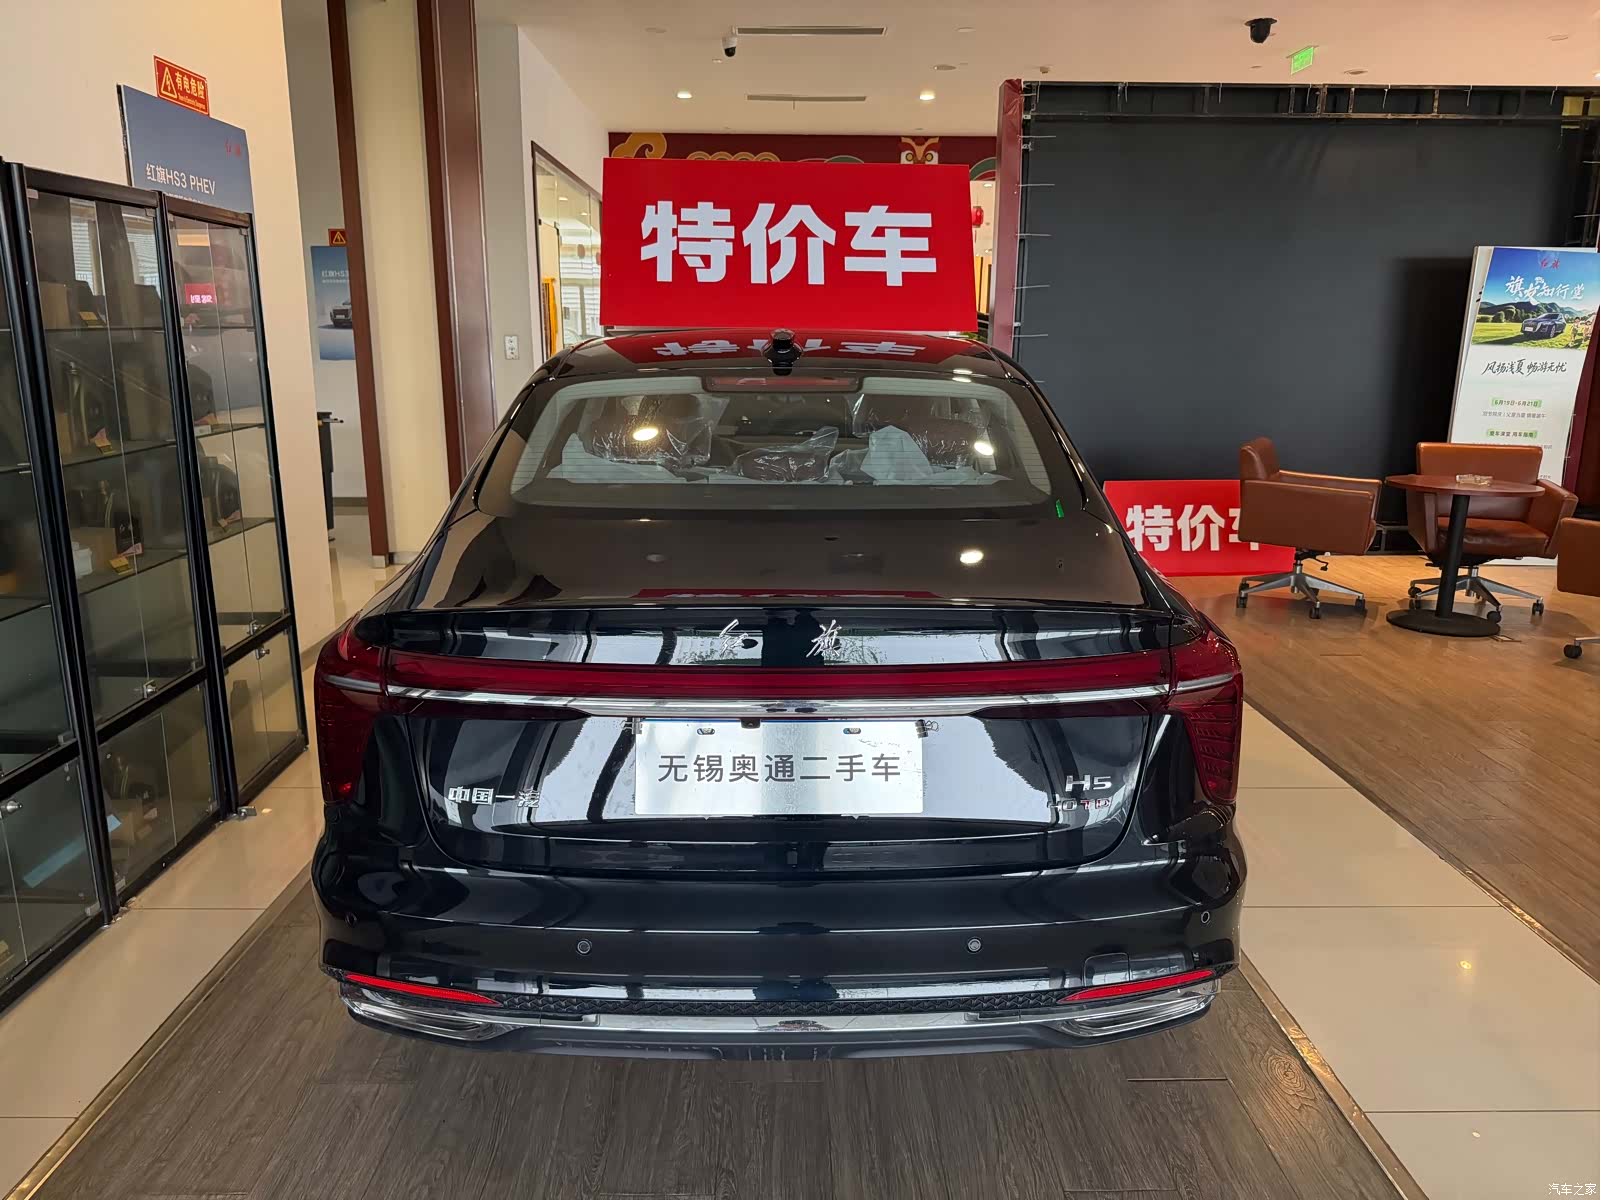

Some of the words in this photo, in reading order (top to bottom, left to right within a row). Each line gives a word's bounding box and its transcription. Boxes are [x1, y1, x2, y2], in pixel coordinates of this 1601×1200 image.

[175, 71, 205, 99] 有电危险
[146, 163, 187, 188] 红旗HS3
[189, 174, 216, 195] PHEV
[641, 200, 937, 286] 特价车
[1526, 361, 1567, 377] 畅游无忧
[718, 619, 843, 658] 红旗
[658, 753, 901, 782] 无锡奥通二手车
[1065, 774, 1112, 792] H5
